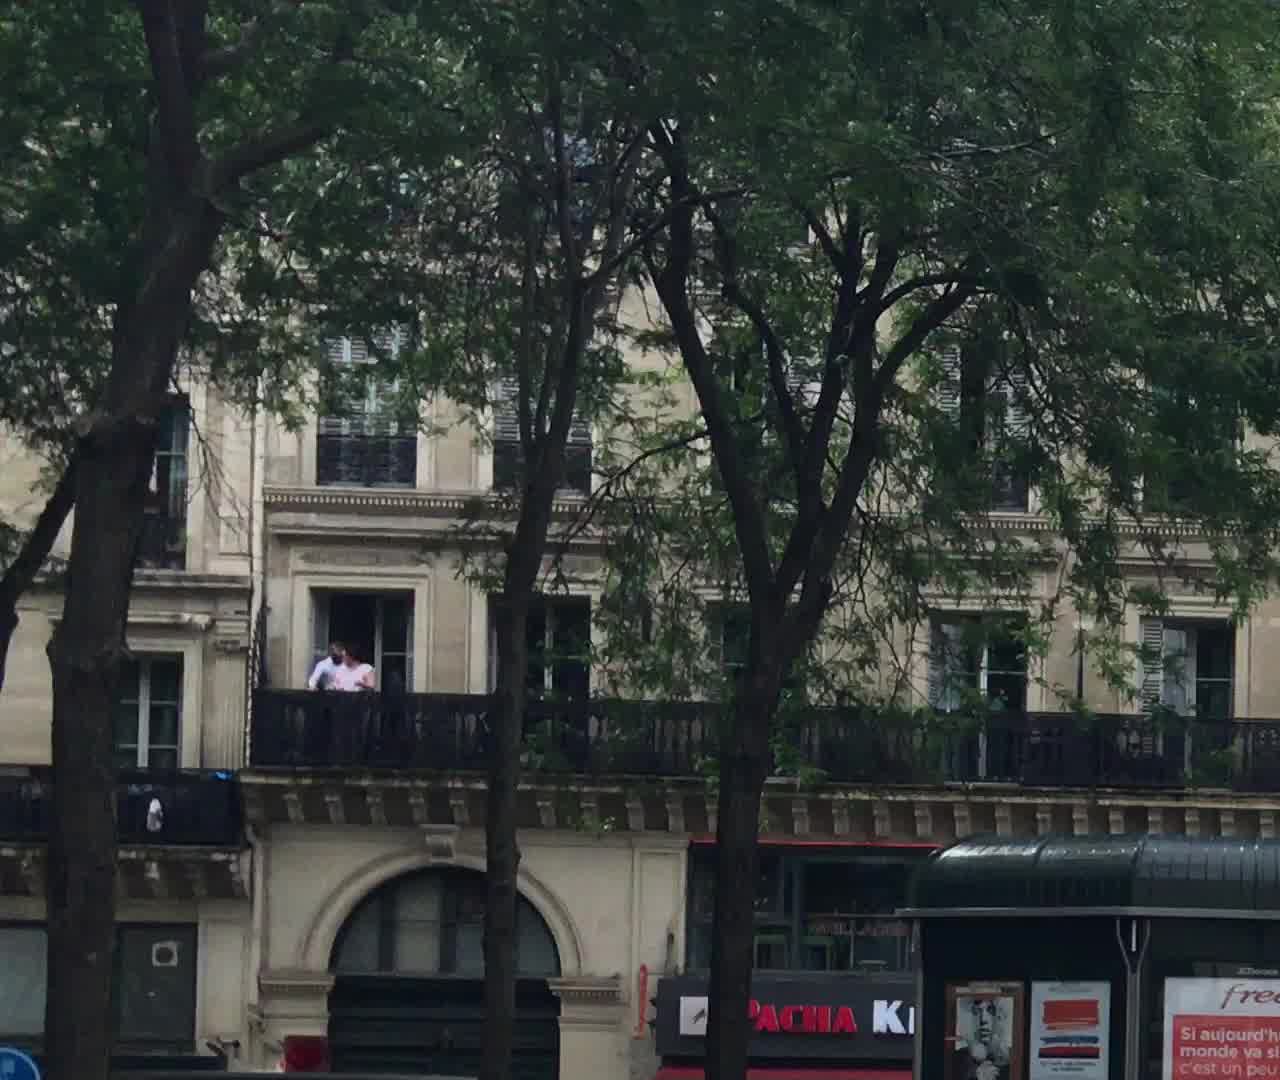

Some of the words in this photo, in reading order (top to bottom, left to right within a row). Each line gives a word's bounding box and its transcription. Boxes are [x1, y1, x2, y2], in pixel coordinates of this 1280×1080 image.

[1180, 1027, 1196, 1041] Si
[1180, 1045, 1238, 1058] monde
[1243, 1048, 1263, 1060] va
[1267, 1046, 1280, 1059] si
[1179, 1062, 1217, 1075] c'est
[1221, 1063, 1242, 1075] un
[1247, 1065, 1277, 1077] peu
